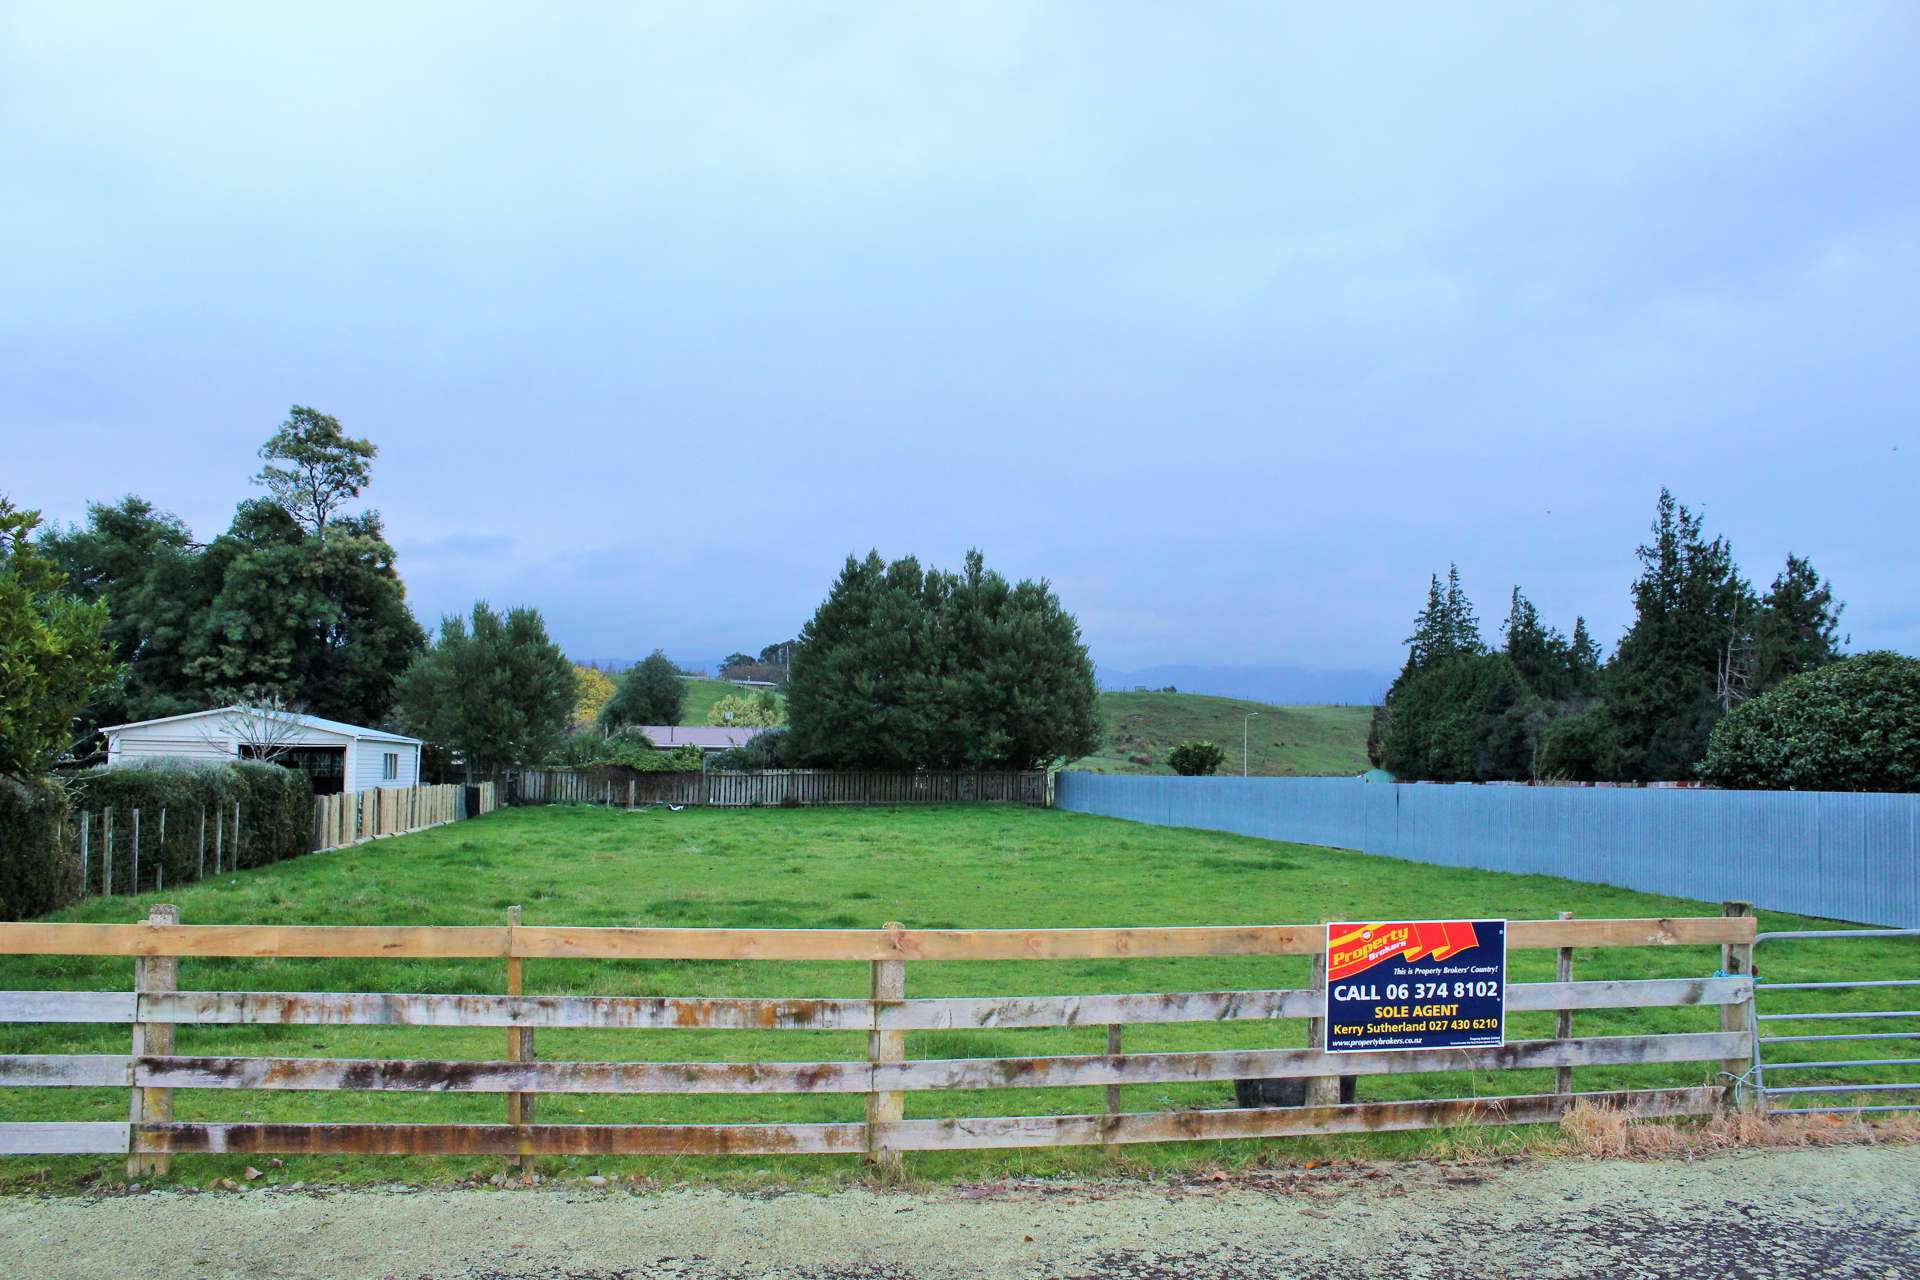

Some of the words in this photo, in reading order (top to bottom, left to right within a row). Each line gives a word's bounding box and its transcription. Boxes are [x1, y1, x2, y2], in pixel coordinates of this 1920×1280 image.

[1334, 928, 1409, 966] Property
[1369, 941, 1407, 961] Brokers
[1415, 968, 1442, 976] Property
[1471, 966, 1498, 974] Country!
[1335, 985, 1380, 1002] CALL
[1387, 984, 1409, 1000] 06
[1415, 983, 1448, 998] 374
[1454, 982, 1498, 997] 8102
[1375, 1006, 1409, 1019] SOLE
[1413, 1005, 1458, 1017] AGENT
[1334, 1025, 1363, 1036] Kerry
[1367, 1021, 1426, 1033] Sutherland
[1429, 1021, 1448, 1030] 027
[1451, 1020, 1470, 1030] 430
[1473, 1019, 1498, 1029] 6210
[1333, 1038, 1422, 1047] www.propertybrokers.co.nz
